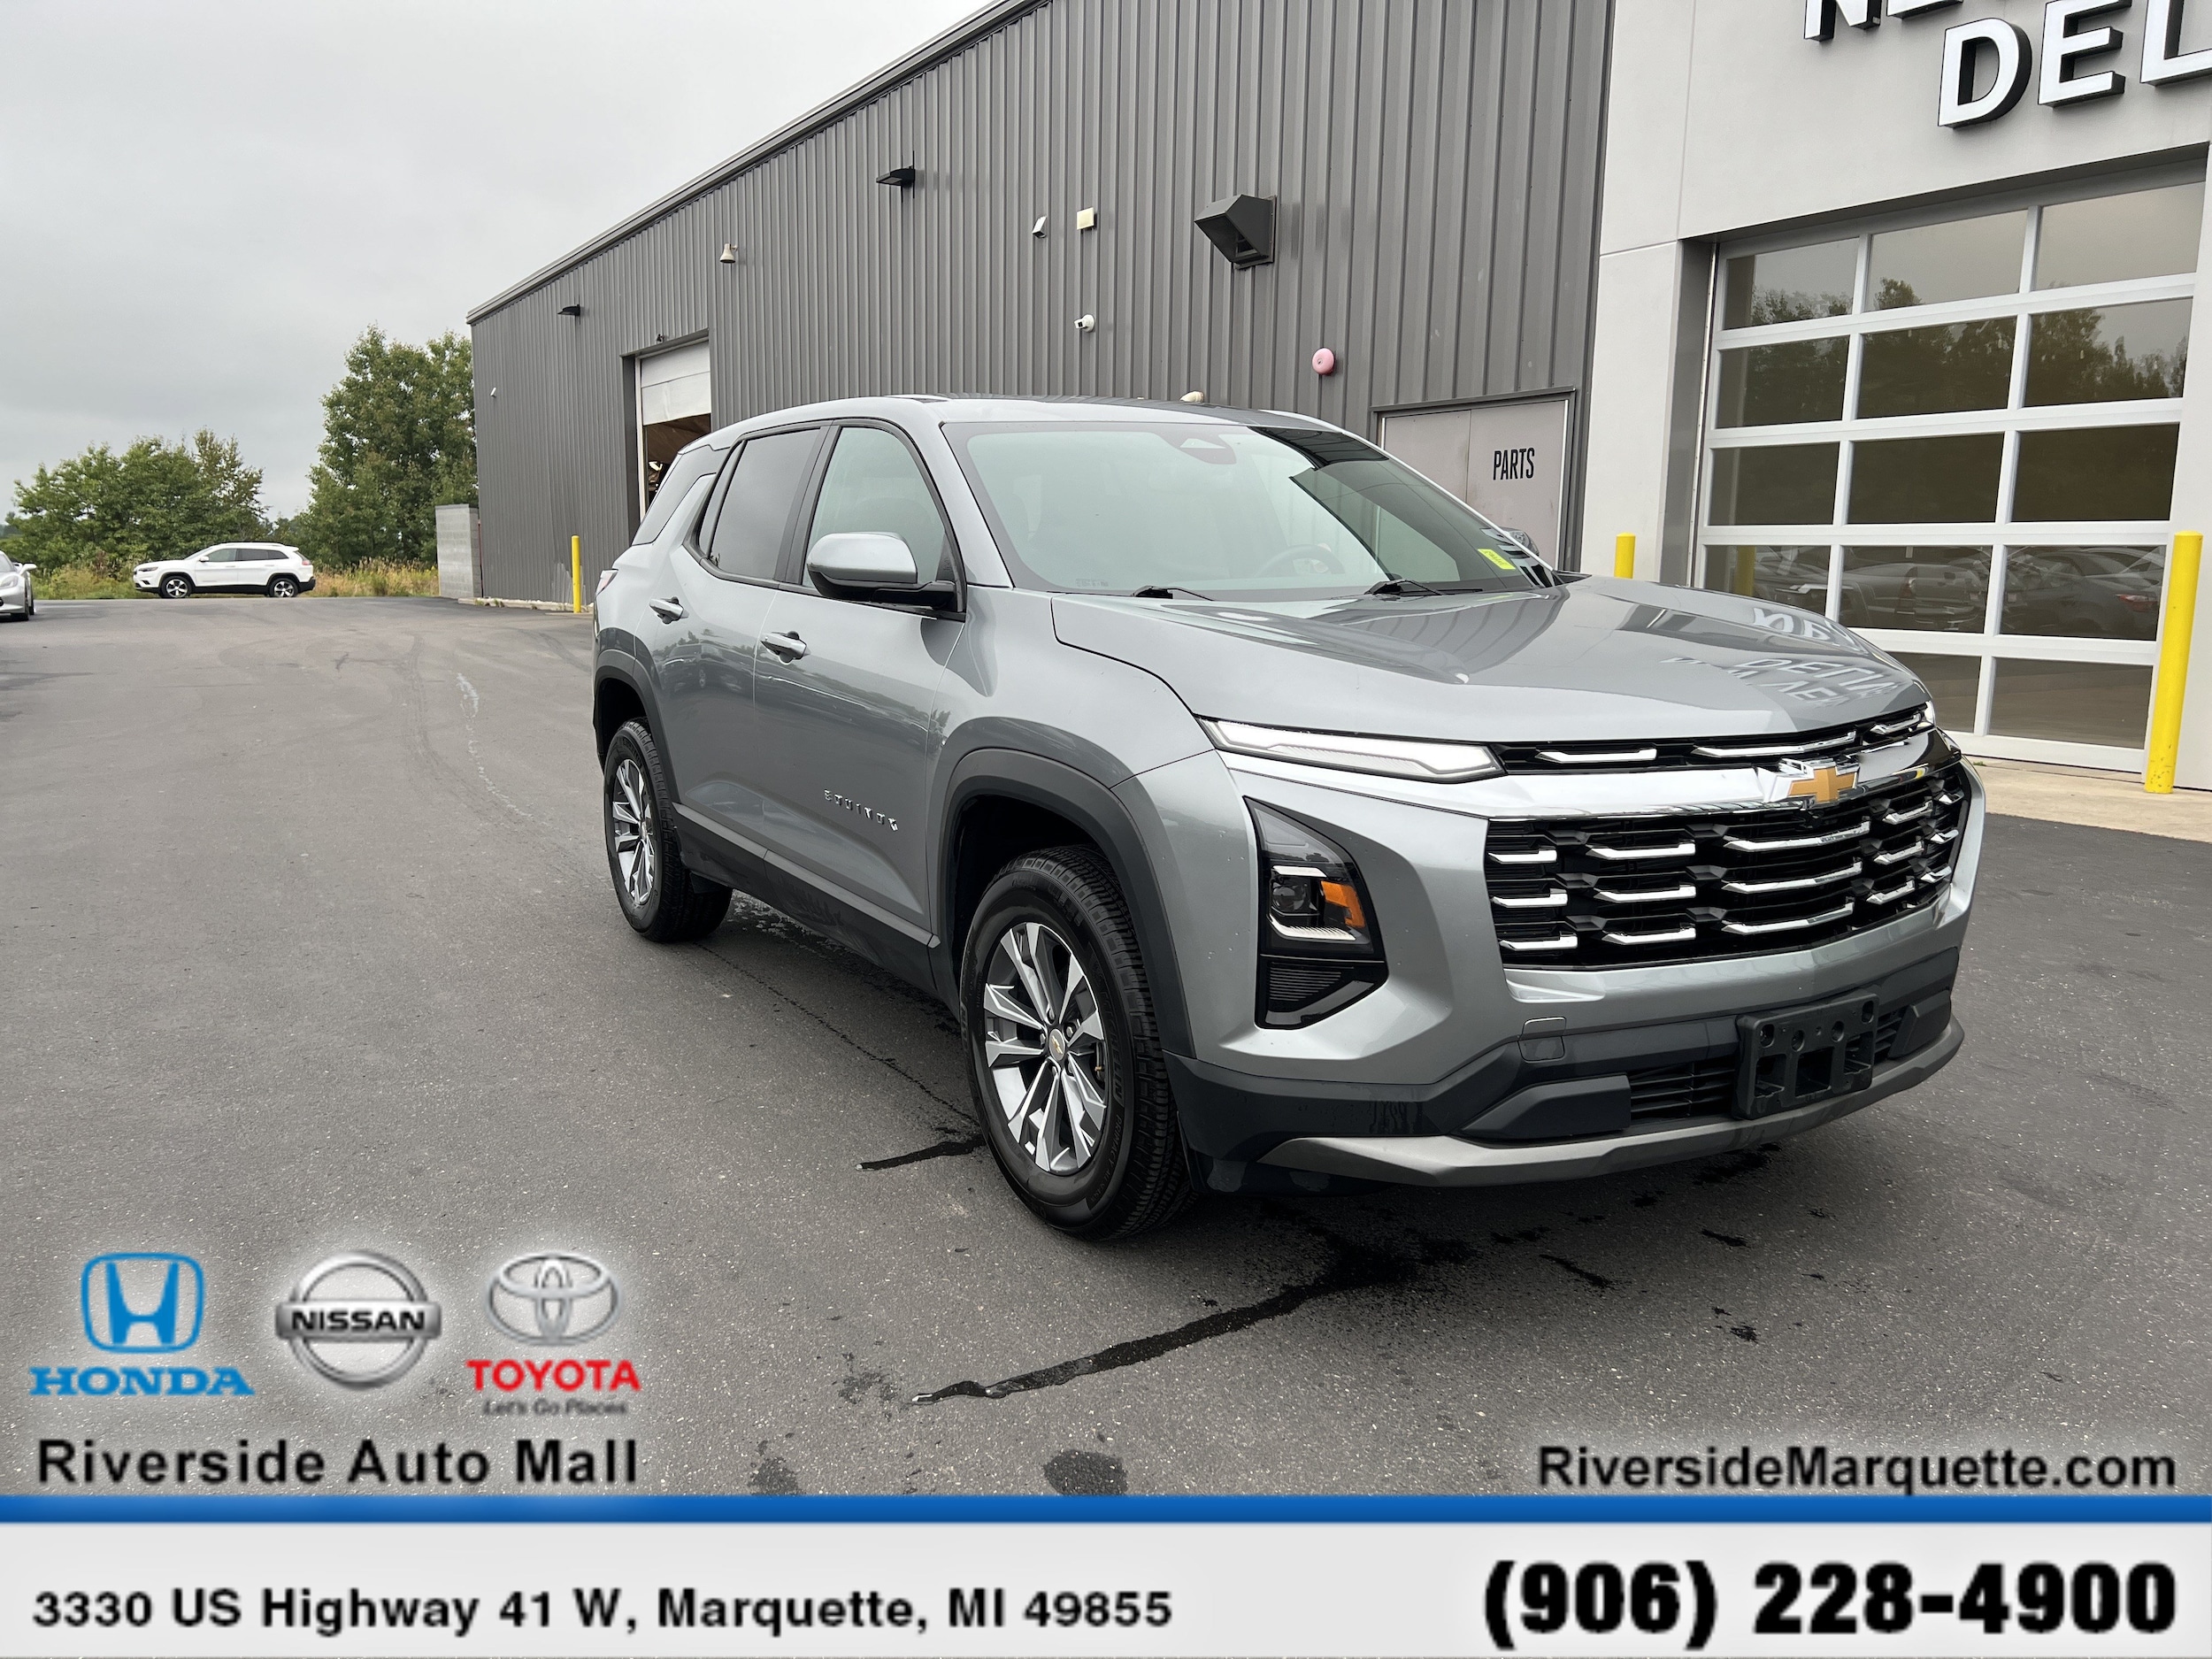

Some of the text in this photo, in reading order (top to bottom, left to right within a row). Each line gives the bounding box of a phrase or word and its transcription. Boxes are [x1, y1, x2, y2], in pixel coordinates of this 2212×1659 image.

[1938, 0, 2212, 128] DEL
[1493, 447, 1535, 480] PARTS
[824, 789, 898, 831] EQUINOX
